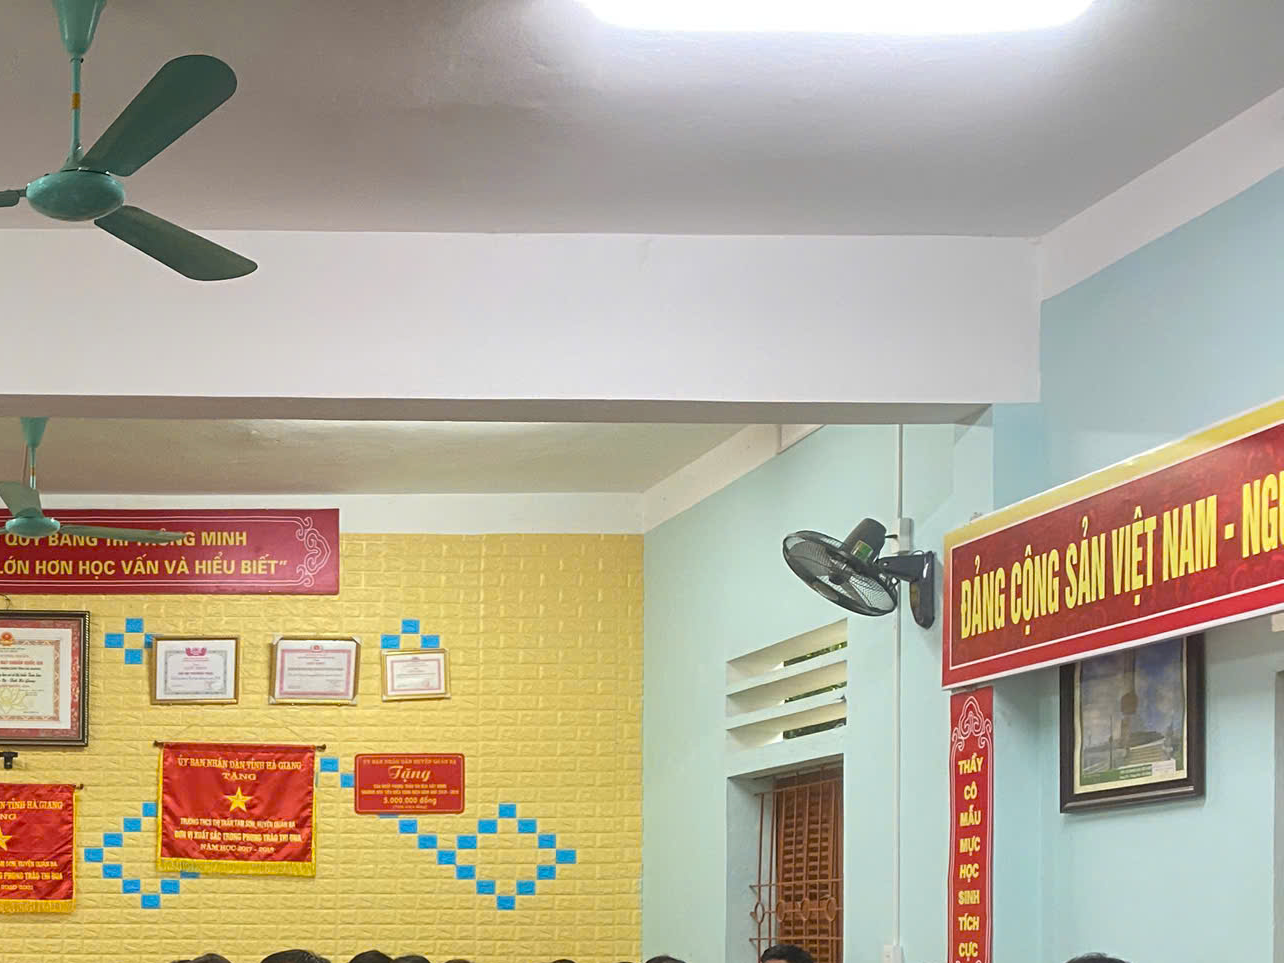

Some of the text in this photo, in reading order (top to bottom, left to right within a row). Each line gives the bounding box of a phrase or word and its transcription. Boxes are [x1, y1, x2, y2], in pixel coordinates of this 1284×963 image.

[201, 531, 247, 547] MINH
[961, 555, 1005, 639] ĐẢNG
[1010, 544, 1059, 635] CỘNG
[1065, 516, 1106, 610] SẢN
[1112, 506, 1157, 606] VIỆT
[1162, 495, 1217, 582] NAM
[1242, 469, 1284, 558] NG
[35, 558, 73, 575] HƠN
[78, 560, 116, 580] HỌC
[121, 554, 159, 576] VẤN
[164, 556, 190, 576] VÀ
[195, 551, 235, 576] HIỂU
[278, 761, 302, 771] GIANG
[388, 765, 431, 782] Tặng
[39, 800, 63, 810] GIANG
[958, 752, 983, 962] THẦY CÔ MẪU MỰC HỌC SINH TÍCH CỰC
